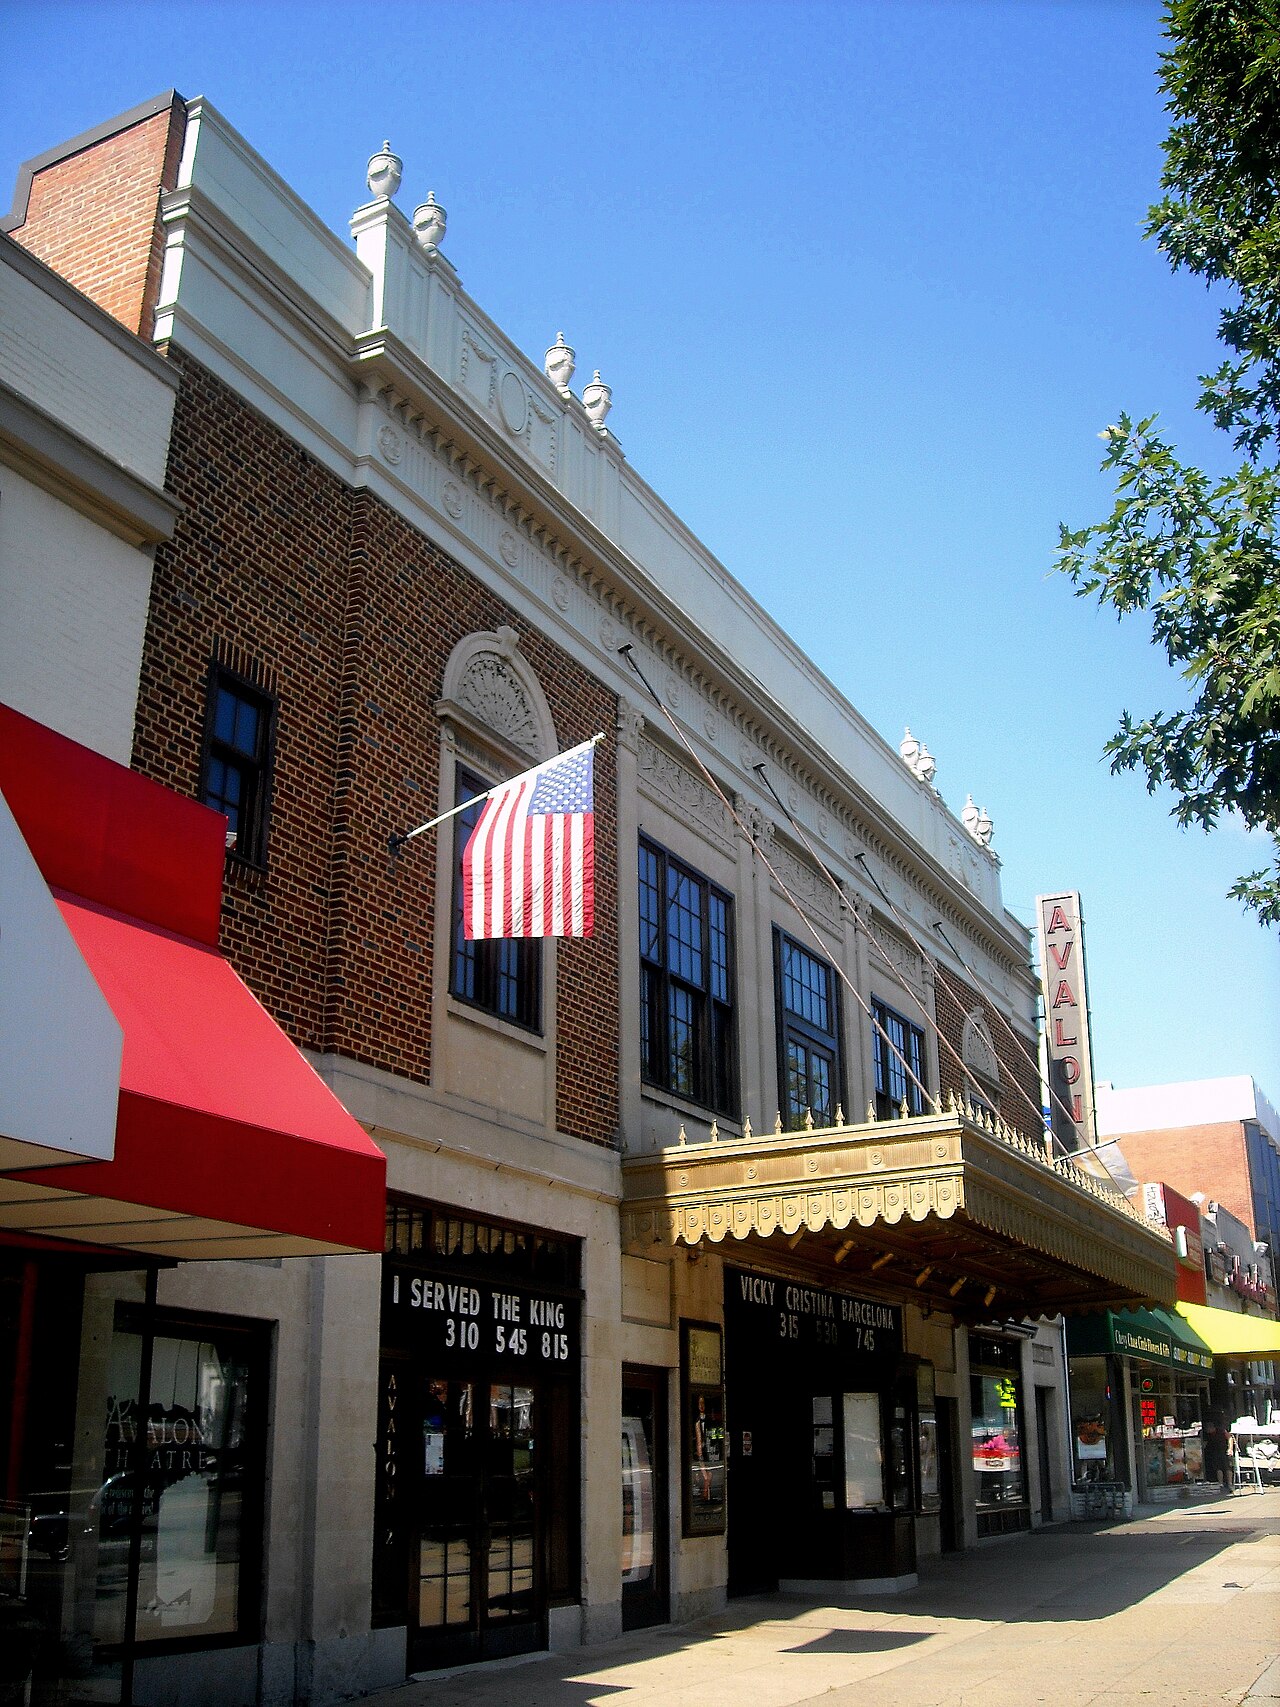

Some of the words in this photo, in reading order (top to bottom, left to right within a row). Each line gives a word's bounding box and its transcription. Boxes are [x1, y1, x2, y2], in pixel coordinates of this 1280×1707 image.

[393, 1275, 400, 1304] I
[411, 1278, 480, 1316] SERVED
[492, 1293, 521, 1323] THE
[530, 1299, 565, 1329] KING
[740, 1275, 775, 1306] VICKY
[786, 1286, 835, 1318] CRISTINA
[841, 1299, 894, 1331] BARCELONA
